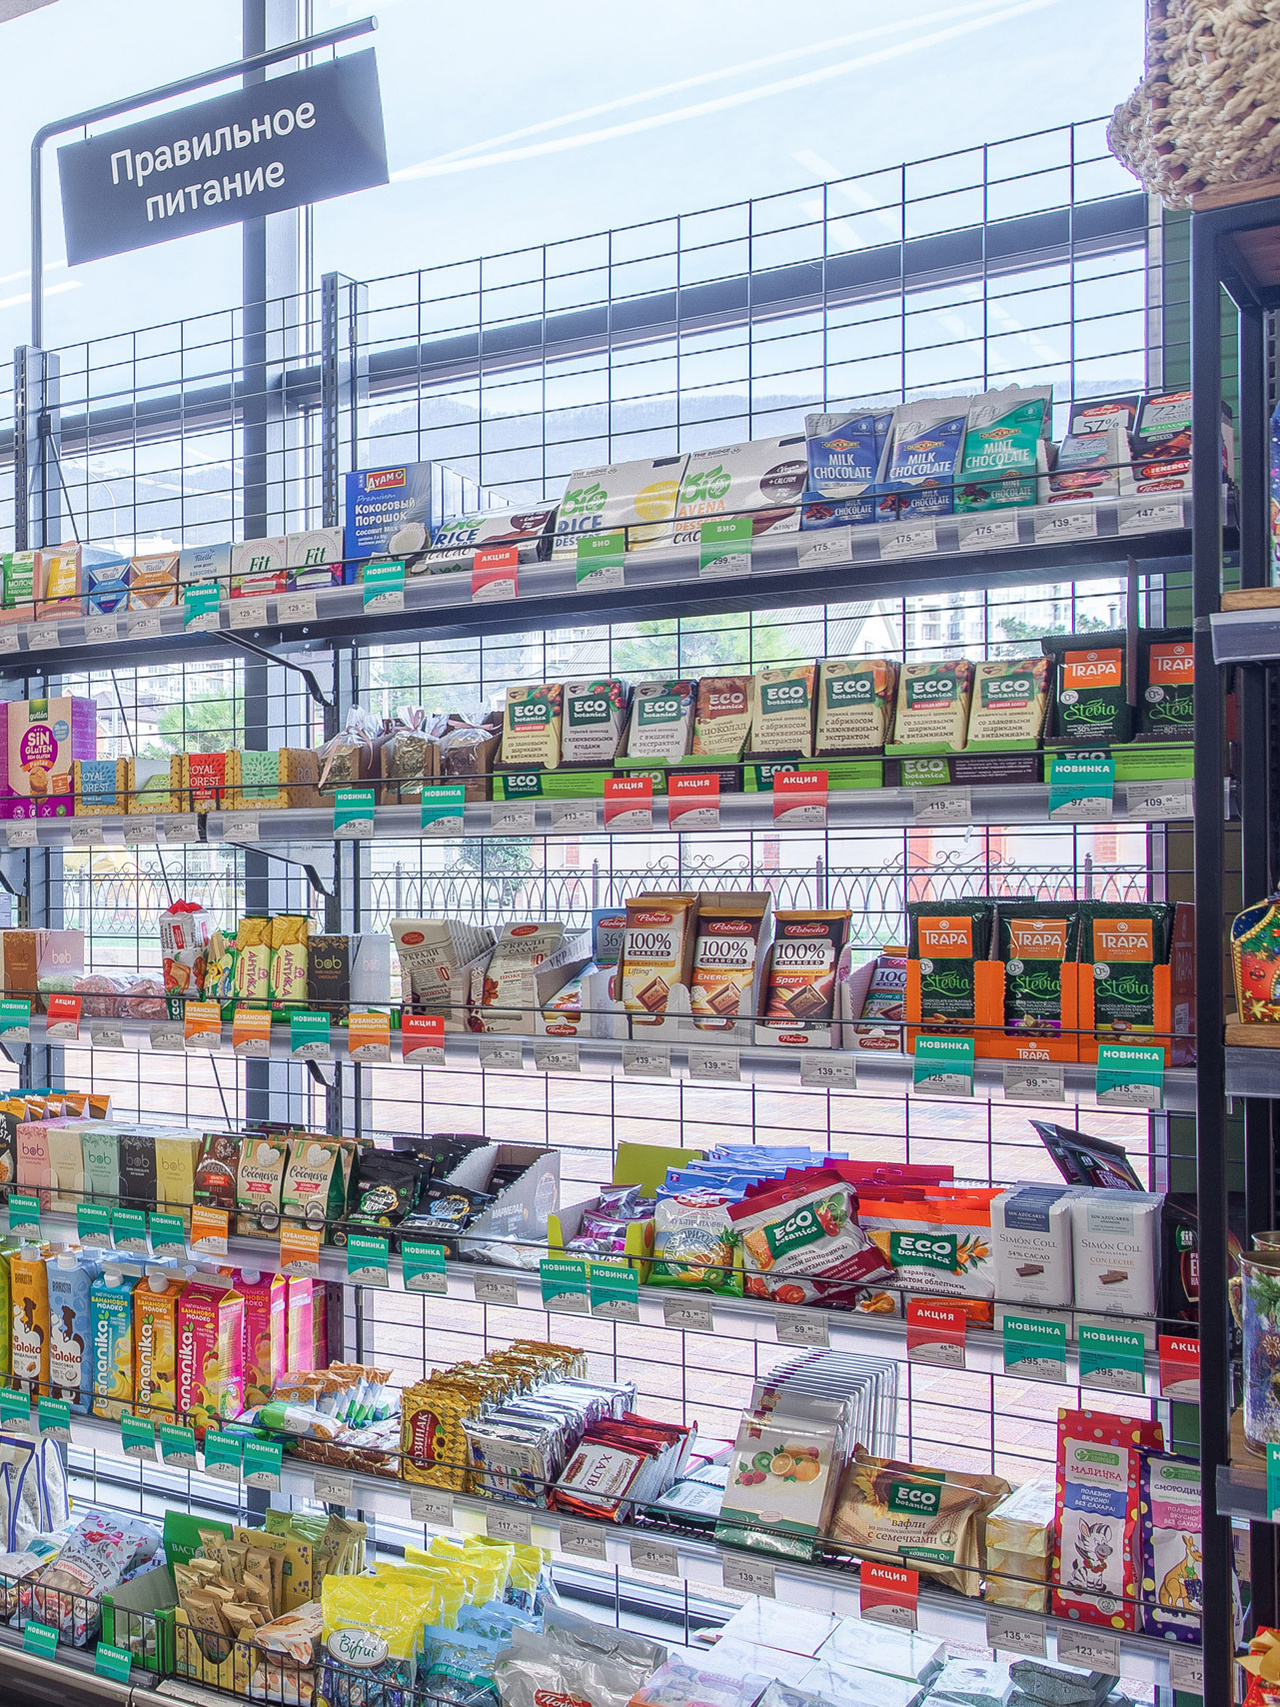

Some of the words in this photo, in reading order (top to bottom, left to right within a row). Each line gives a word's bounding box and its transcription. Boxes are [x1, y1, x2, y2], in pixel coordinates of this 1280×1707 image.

[111, 101, 317, 187] Правильное
[145, 161, 286, 222] питание
[984, 439, 1013, 453] MINT
[829, 454, 854, 465] MILK
[908, 452, 936, 464] MILK
[965, 449, 1030, 469] CHOCOLATE
[814, 466, 872, 479] CHOCOLATE
[889, 461, 951, 479] CHOCOLATE
[990, 487, 1032, 499] CHOCOLATE
[911, 496, 950, 507] CHOCOLATE
[678, 501, 726, 518] AVENA
[835, 505, 872, 516] CHOCOLATE
[716, 524, 736, 532] БИО
[435, 528, 479, 546] RICE
[592, 539, 610, 548] БИО
[481, 552, 510, 562] АКЦИЯ
[366, 565, 402, 575] НОВИНКА
[187, 588, 217, 597] НОВИНКА
[1071, 661, 1116, 677] TRAPA
[832, 679, 870, 693] ECO
[912, 680, 953, 693] ECO
[987, 680, 1029, 693] ECO
[709, 693, 744, 705] ECO
[767, 687, 804, 699] ECO
[831, 690, 871, 700] botanica
[912, 691, 953, 699] botanica
[987, 690, 1030, 699] botanica
[708, 702, 745, 711] botanica
[767, 696, 805, 705] botanica
[514, 705, 546, 716] ECO
[574, 701, 607, 713] ECO
[643, 702, 678, 713] ECO
[1063, 698, 1119, 722] Stevia
[514, 714, 546, 723] botanica
[574, 710, 607, 718] botanica
[643, 709, 679, 718] botanica
[904, 770, 945, 779] botanica
[1055, 764, 1110, 773] НОВИНКА
[507, 775, 537, 787] ECO
[677, 779, 709, 788] АКЦИЯ
[783, 775, 817, 784] АКЦИЯ
[508, 784, 538, 792] botanica
[612, 782, 643, 790] АКЦИЯ
[628, 932, 672, 950] 100%
[922, 930, 968, 945] TRAPA
[1017, 930, 1062, 946] TRAPA
[1097, 933, 1149, 948] TRAPA
[701, 941, 748, 958] 100%
[777, 943, 826, 960] 100%
[314, 955, 342, 969] bob
[401, 949, 440, 963] УКРАЛИ
[411, 957, 436, 966] САХАР
[246, 950, 259, 998] АНТИКА
[921, 971, 971, 997] Stevia
[1095, 975, 1152, 1002] Stevia
[55, 998, 76, 1006] АКЦИЯ
[919, 1040, 970, 1050] НОВИНКА
[1103, 1050, 1159, 1061] НОВИНКА
[22, 1142, 44, 1157] bob
[88, 1150, 111, 1165] bob
[126, 1153, 149, 1168] bob
[161, 1157, 185, 1171] bob
[11, 1198, 37, 1207] НОВИНКА
[79, 1207, 107, 1217] НОВИНКА
[114, 1211, 143, 1220] НОВИНКА
[194, 1210, 227, 1220] КУБАНСКИЙ
[151, 1216, 181, 1226] НОВИНКА
[773, 1211, 813, 1240] ECO
[283, 1232, 318, 1241] КУБАНСКИЙ
[775, 1224, 818, 1247] botanica
[350, 1240, 385, 1250] НОВИНКА
[405, 1246, 441, 1256] НОВИНКА
[900, 1237, 951, 1254] ECO
[898, 1248, 951, 1264] botanica
[542, 1263, 582, 1273] НОВИНКА
[593, 1269, 635, 1280] НОВИНКА
[91, 1296, 128, 1307] БАНАНОВОЕ
[97, 1303, 123, 1312] МОЛОКО
[137, 1299, 171, 1309] БАНАНОВОЕ
[143, 1305, 167, 1314] МОЛОКО
[181, 1307, 215, 1318] БАНАНОВОЕ
[917, 1309, 954, 1321] АКЦИЯ
[186, 1313, 210, 1323] МОЛОКО
[1008, 1321, 1061, 1335] НОВИНКА
[1083, 1331, 1139, 1345] НОВИНКА
[94, 1318, 109, 1409] bananika
[1, 1392, 28, 1403] НОВИНКА
[40, 1400, 67, 1411] НОВИНКА
[122, 1417, 152, 1430] НОВИНКА
[162, 1425, 192, 1438] НОВИНКА
[208, 1434, 239, 1447] НОВИНКА
[246, 1442, 279, 1455] НОВИНКА
[1071, 1465, 1122, 1481] МАЛИНКА
[898, 1486, 936, 1504] ECO
[1081, 1488, 1111, 1498] ПОЛЕЗНО!
[895, 1498, 934, 1512] botanica
[1082, 1495, 1109, 1504] ВКУСНО!
[1087, 1503, 1115, 1512] САХАРА!
[891, 1519, 926, 1529] вафли
[870, 1568, 908, 1582] АКЦИЯ
[27, 1625, 56, 1640] НОВИНКА
[339, 1635, 378, 1661] Bifrut
[99, 1647, 129, 1663] НОВИНКА
